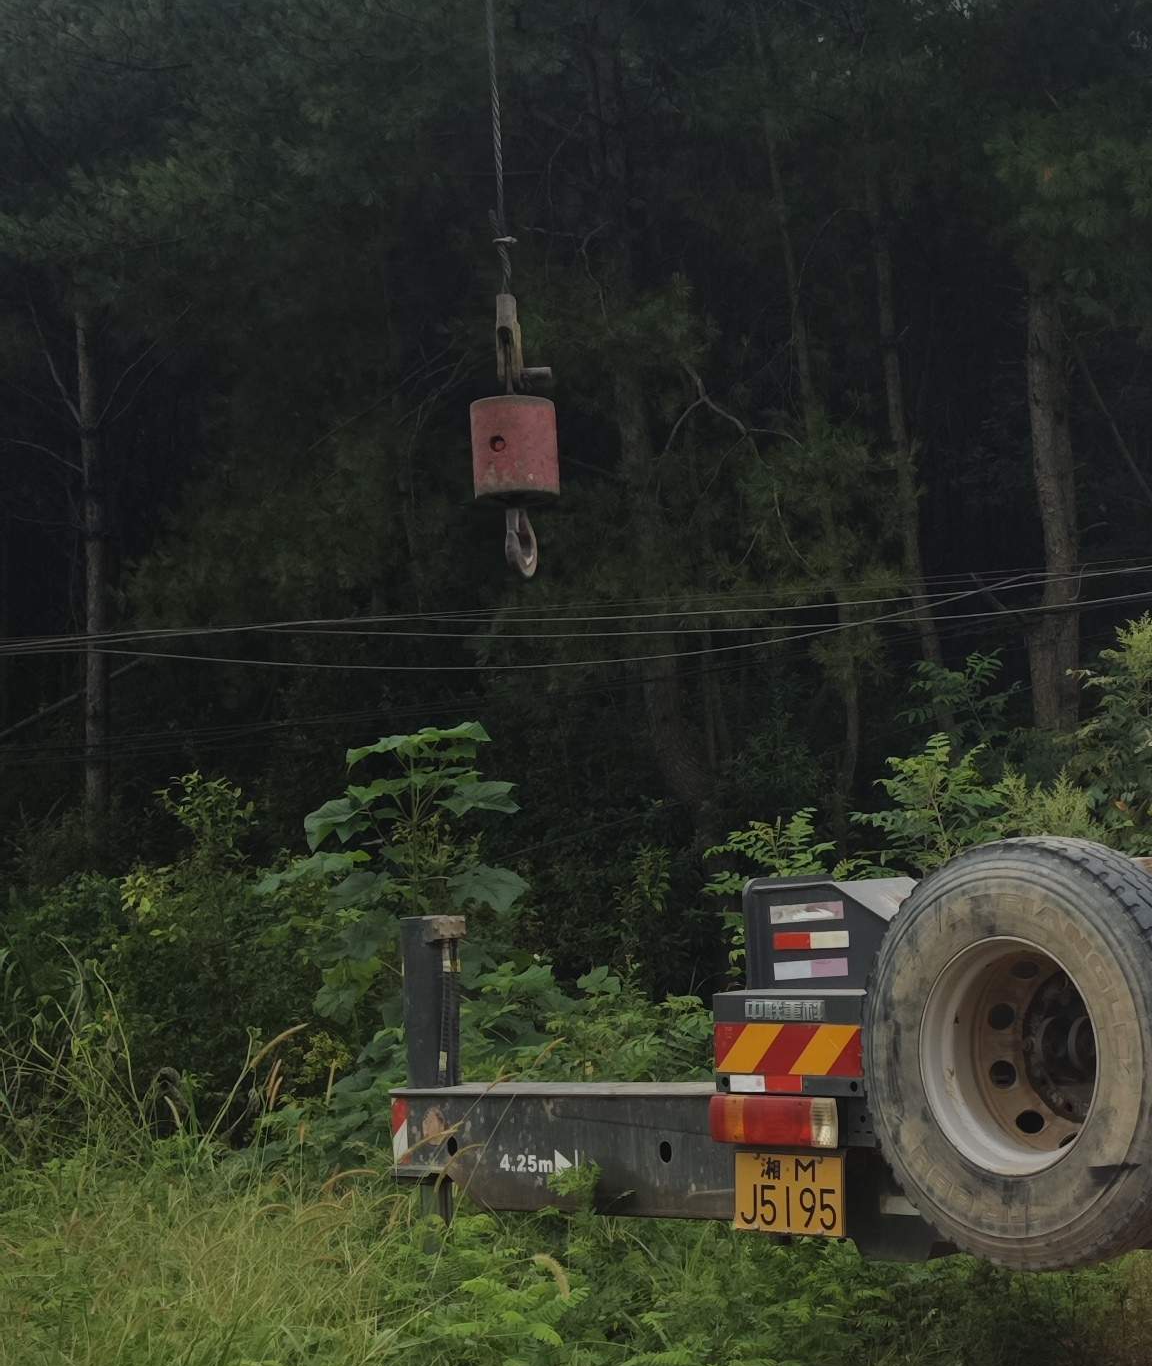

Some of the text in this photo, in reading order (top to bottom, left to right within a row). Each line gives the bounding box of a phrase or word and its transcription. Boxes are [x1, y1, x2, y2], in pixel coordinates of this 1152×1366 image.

[744, 999, 825, 1021] 中联重科
[499, 1152, 554, 1173] 4.25m
[740, 1183, 837, 1231] J5195
